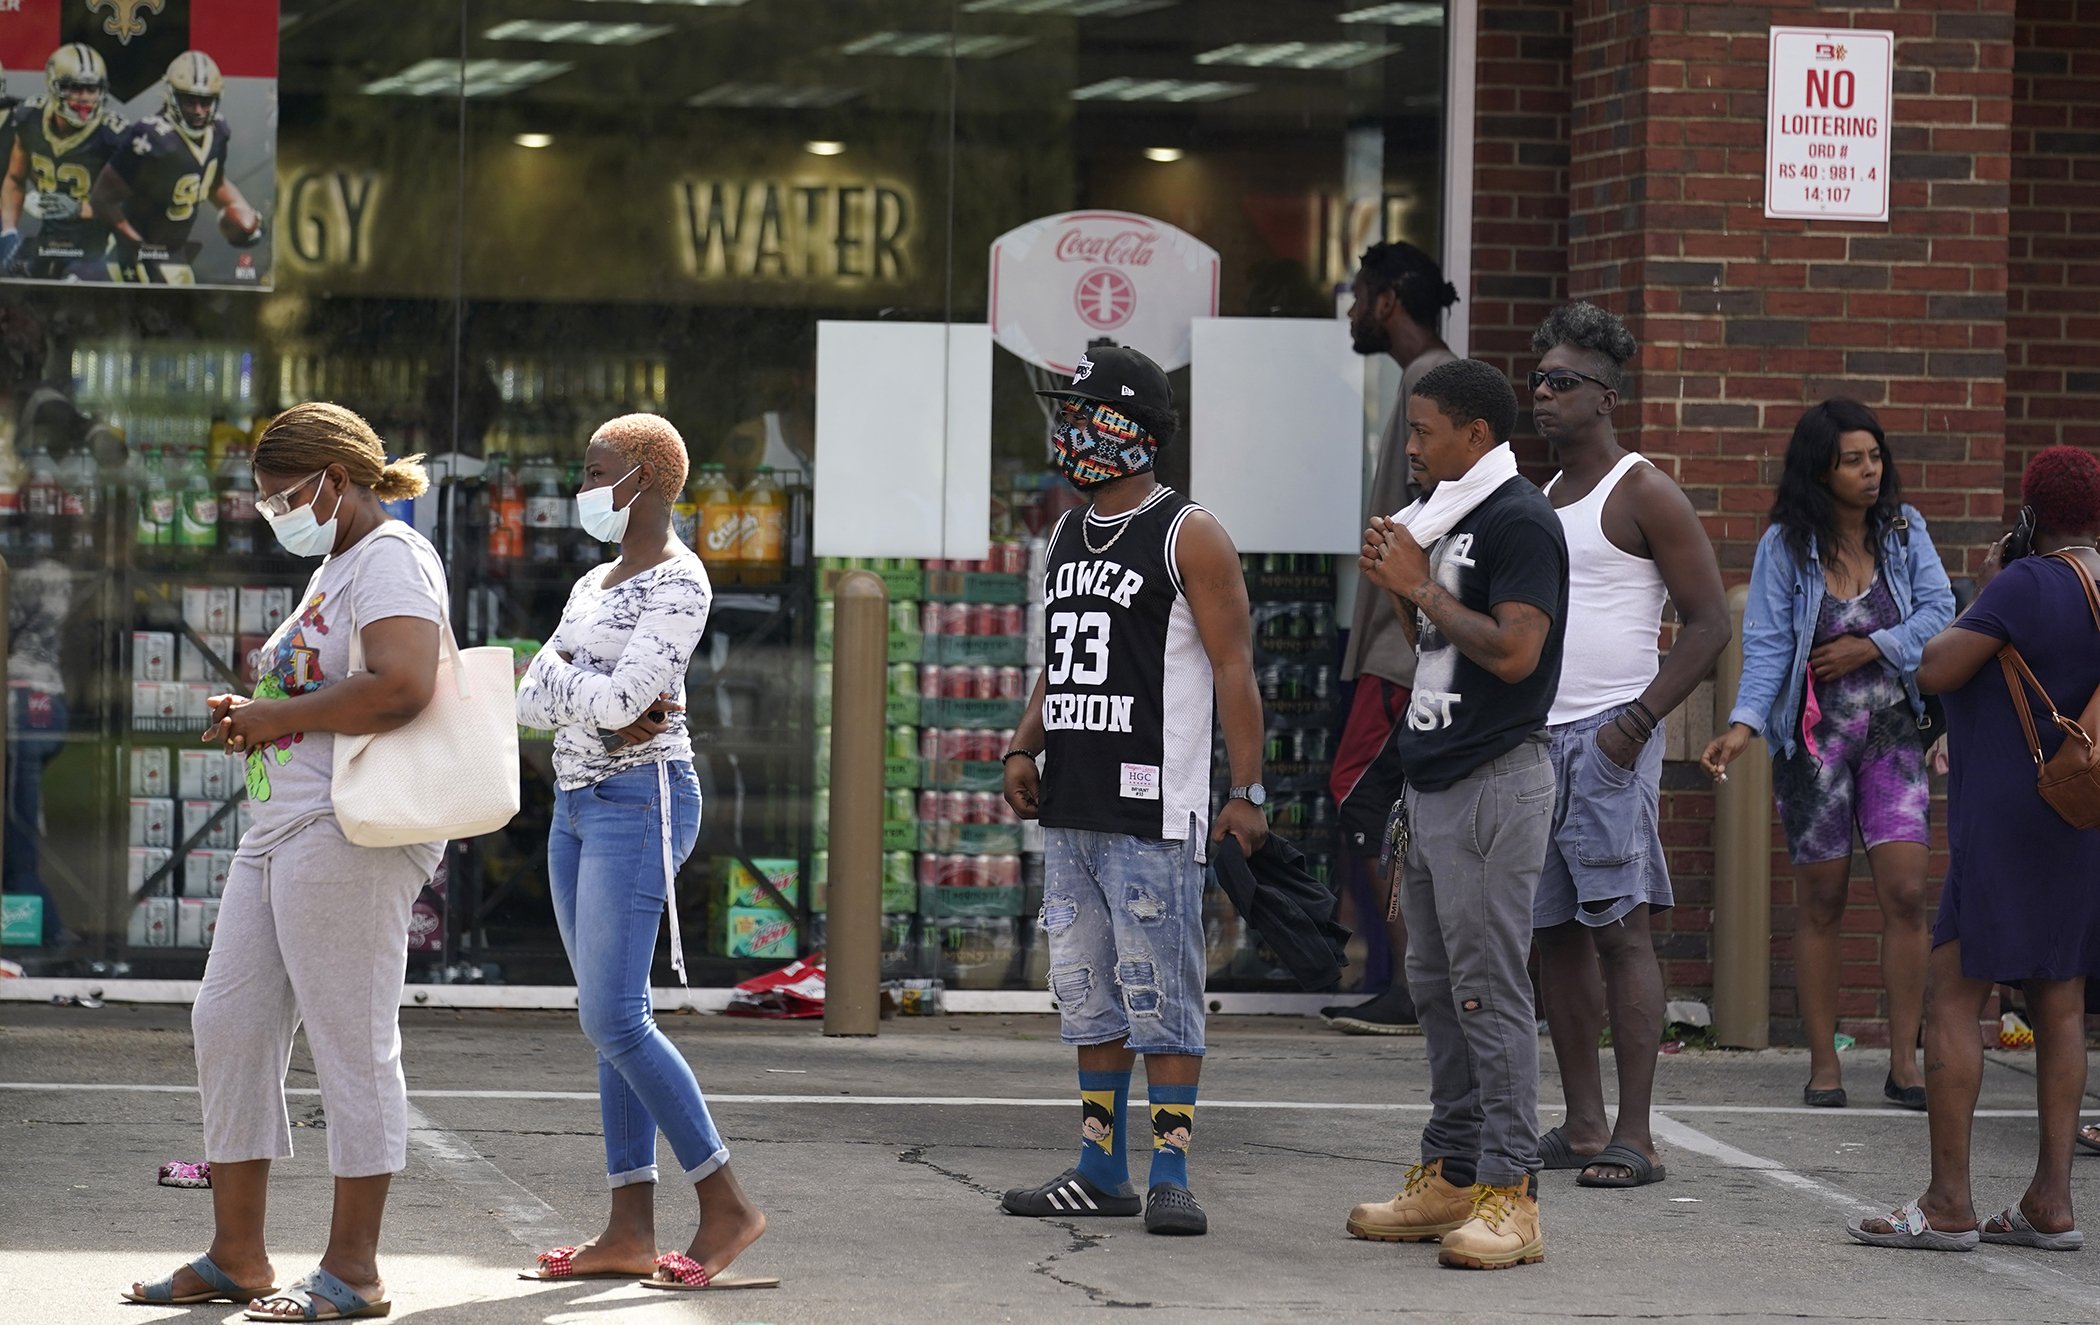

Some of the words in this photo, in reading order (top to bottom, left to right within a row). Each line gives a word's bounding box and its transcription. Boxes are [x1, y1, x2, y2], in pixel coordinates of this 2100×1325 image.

[1806, 69, 1855, 110] NO
[1781, 114, 1877, 138] LOITERING
[1808, 143, 1836, 159] ORD
[1840, 144, 1848, 159] #
[1779, 163, 1796, 179] RS
[685, 181, 909, 279] WATER
[1043, 560, 1144, 610] LOWER
[1048, 611, 1111, 686] 33
[1129, 771, 1152, 782] HGC
[1388, 893, 1399, 921] SMILE
